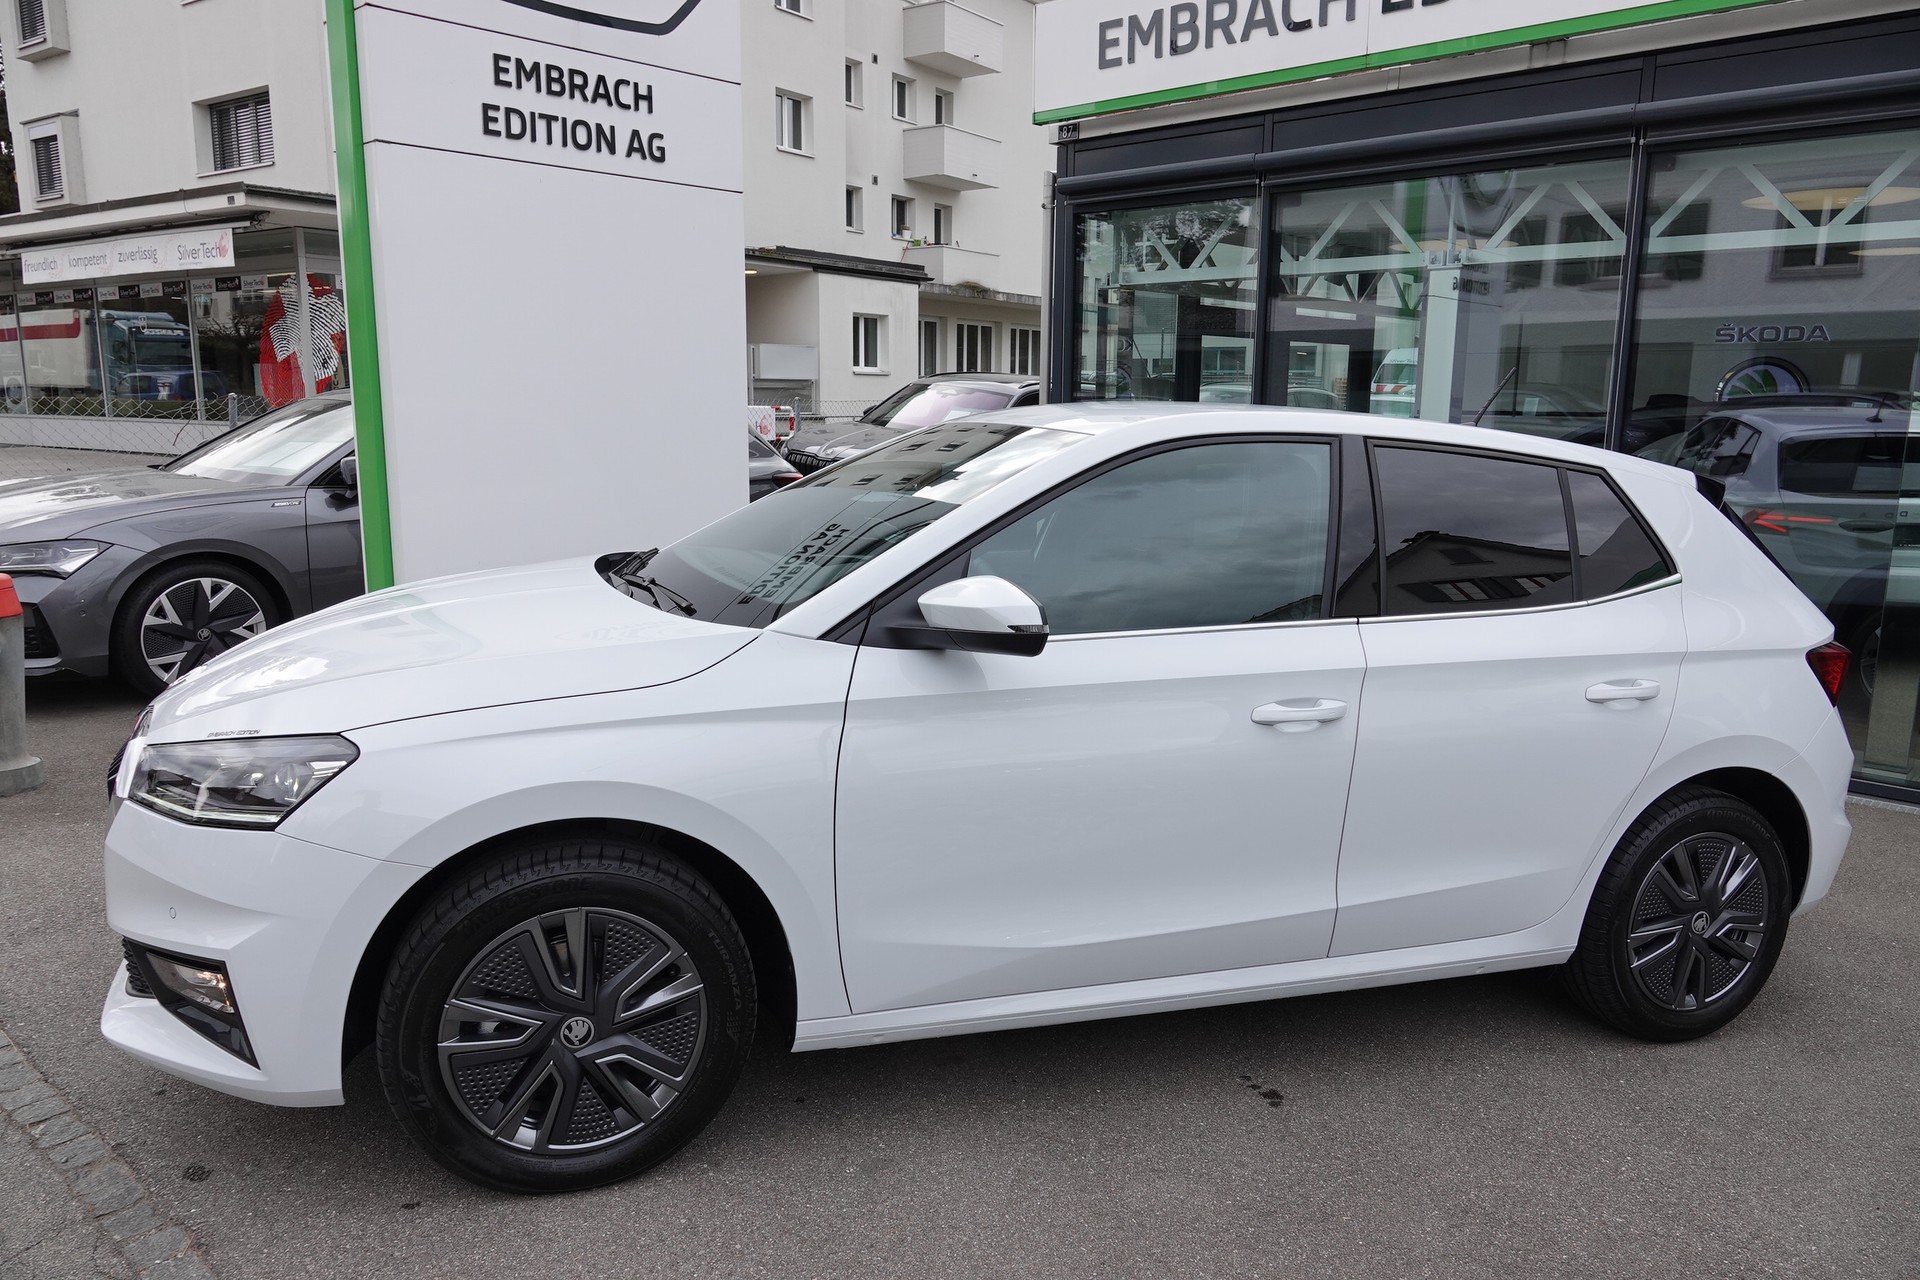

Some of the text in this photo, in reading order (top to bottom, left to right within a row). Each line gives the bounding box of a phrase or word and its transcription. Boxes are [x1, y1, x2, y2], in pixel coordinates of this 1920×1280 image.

[492, 52, 653, 115] EMBRACH
[482, 102, 666, 163] EDITION AG
[1062, 125, 1073, 138] 87
[24, 257, 58, 273] freundlich
[68, 253, 107, 271] kompetent
[177, 242, 221, 261] SilverTech
[1715, 323, 1830, 343] ŠKODA
